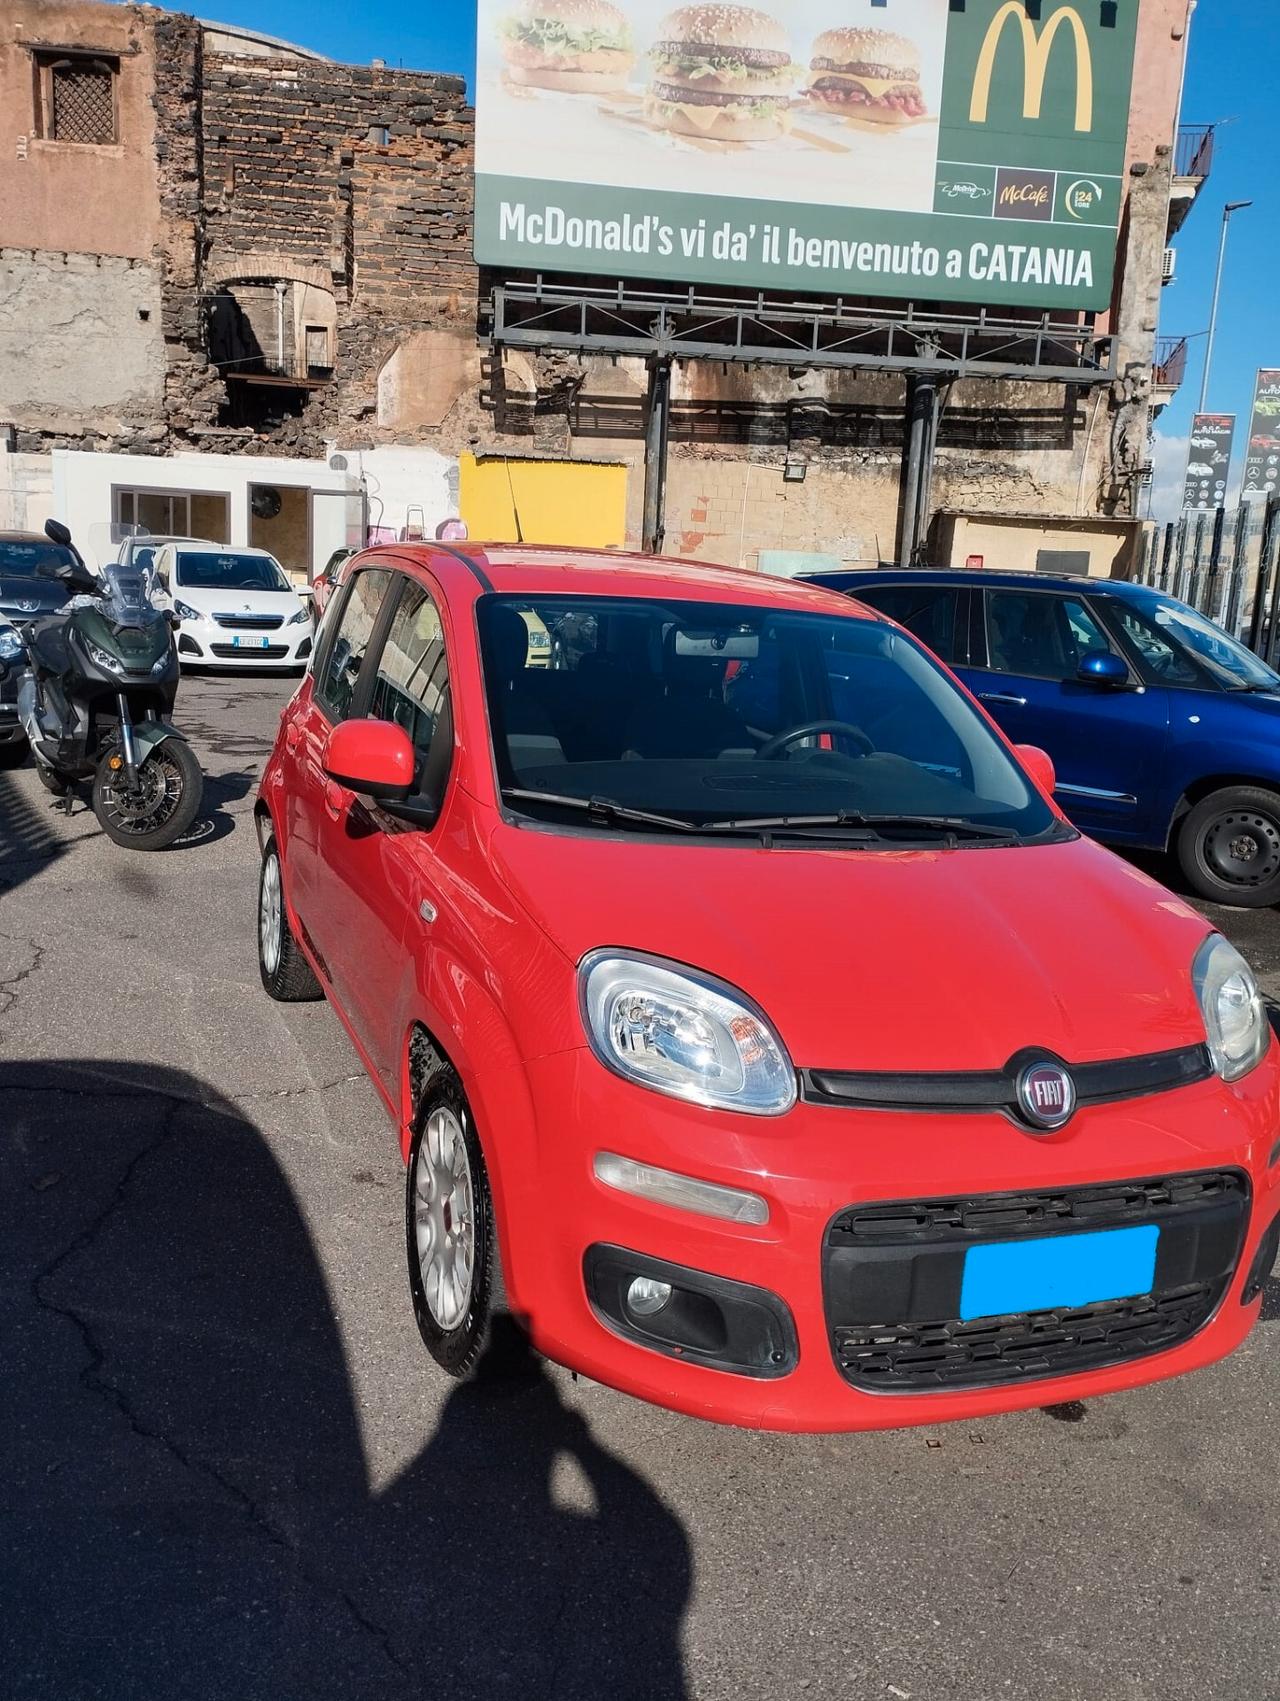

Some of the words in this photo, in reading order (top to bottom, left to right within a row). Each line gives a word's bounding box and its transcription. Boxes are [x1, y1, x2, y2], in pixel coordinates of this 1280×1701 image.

[999, 183, 1047, 207] McCafé
[1078, 191, 1093, 203] 24
[498, 200, 675, 257] McDonald's
[679, 217, 707, 259] vi
[712, 221, 757, 263] da'
[762, 223, 781, 266] il
[787, 227, 941, 278] benvenuto
[945, 249, 962, 278] a
[968, 242, 1093, 288] CATANIA
[1034, 1080, 1063, 1106] FIAT
